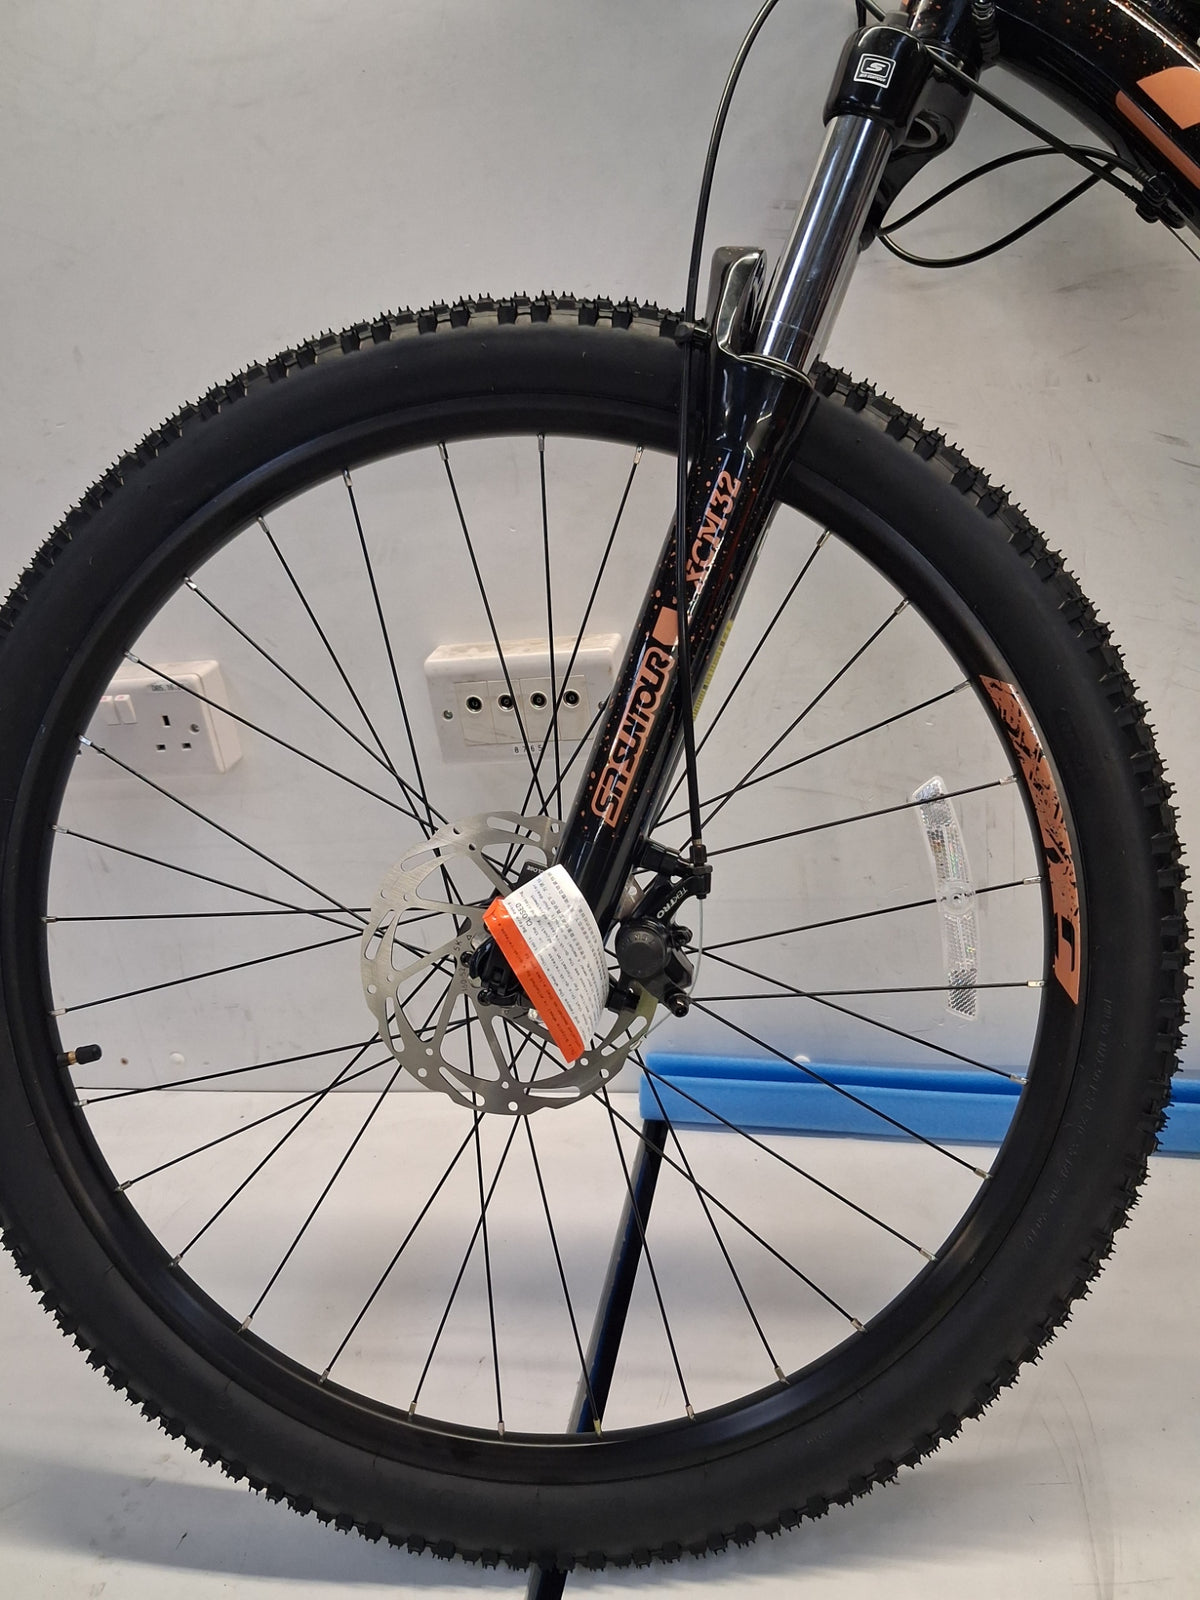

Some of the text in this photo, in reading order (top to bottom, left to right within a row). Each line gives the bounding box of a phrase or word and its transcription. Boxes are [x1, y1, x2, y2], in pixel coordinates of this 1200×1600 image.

[686, 470, 741, 594] XCM32
[514, 902, 533, 927] CLOSED
[657, 887, 688, 918] TEKTRO
